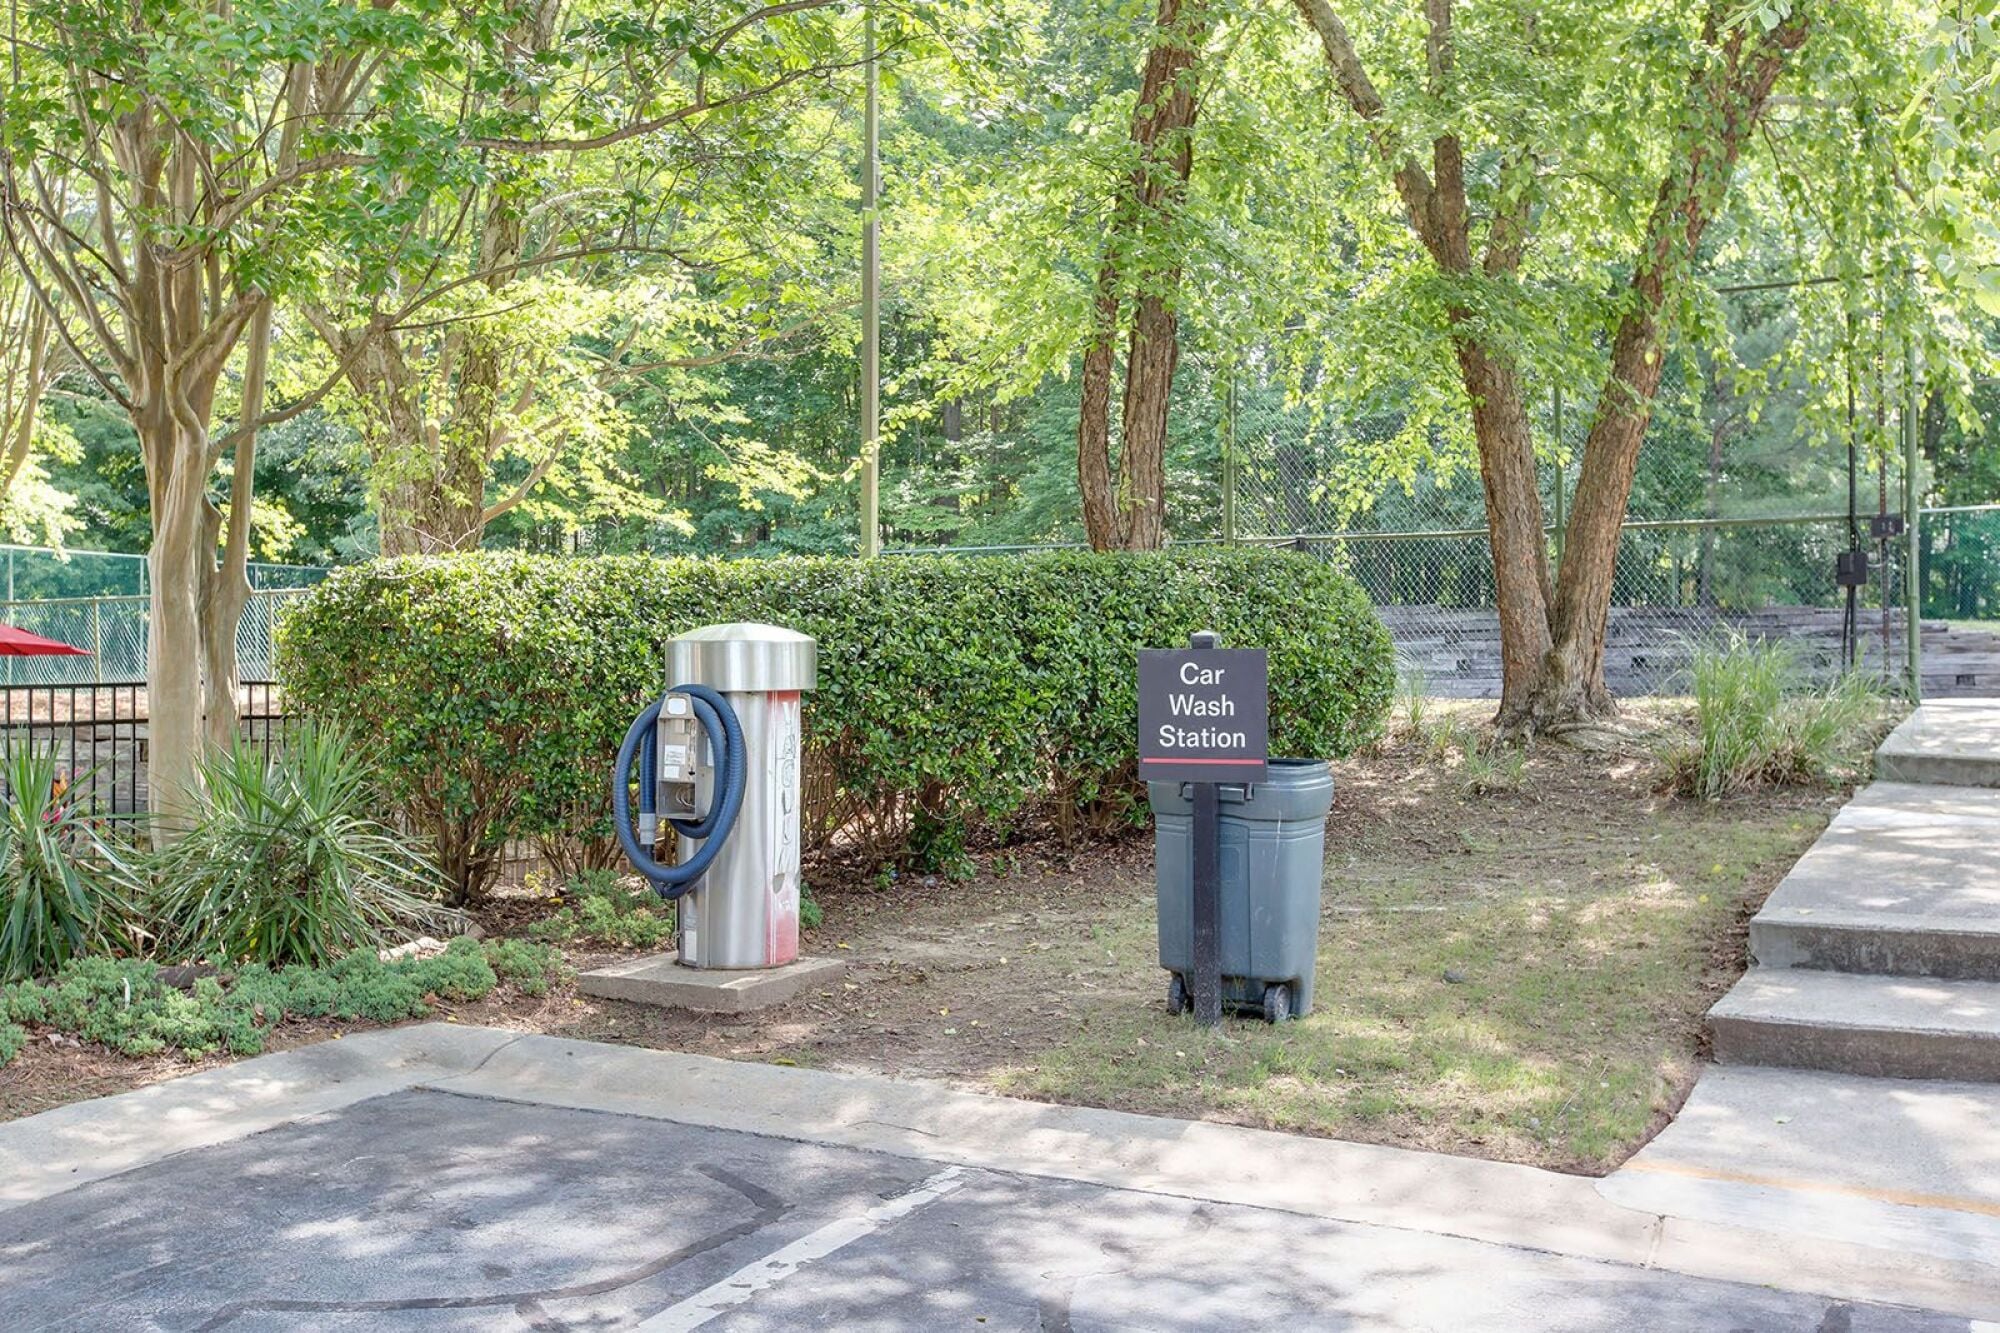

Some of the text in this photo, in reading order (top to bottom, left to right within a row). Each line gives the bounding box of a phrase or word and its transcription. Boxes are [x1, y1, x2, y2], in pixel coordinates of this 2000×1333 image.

[1179, 662, 1225, 685] Car
[1168, 694, 1235, 717] Wash
[1159, 724, 1246, 748] Station
